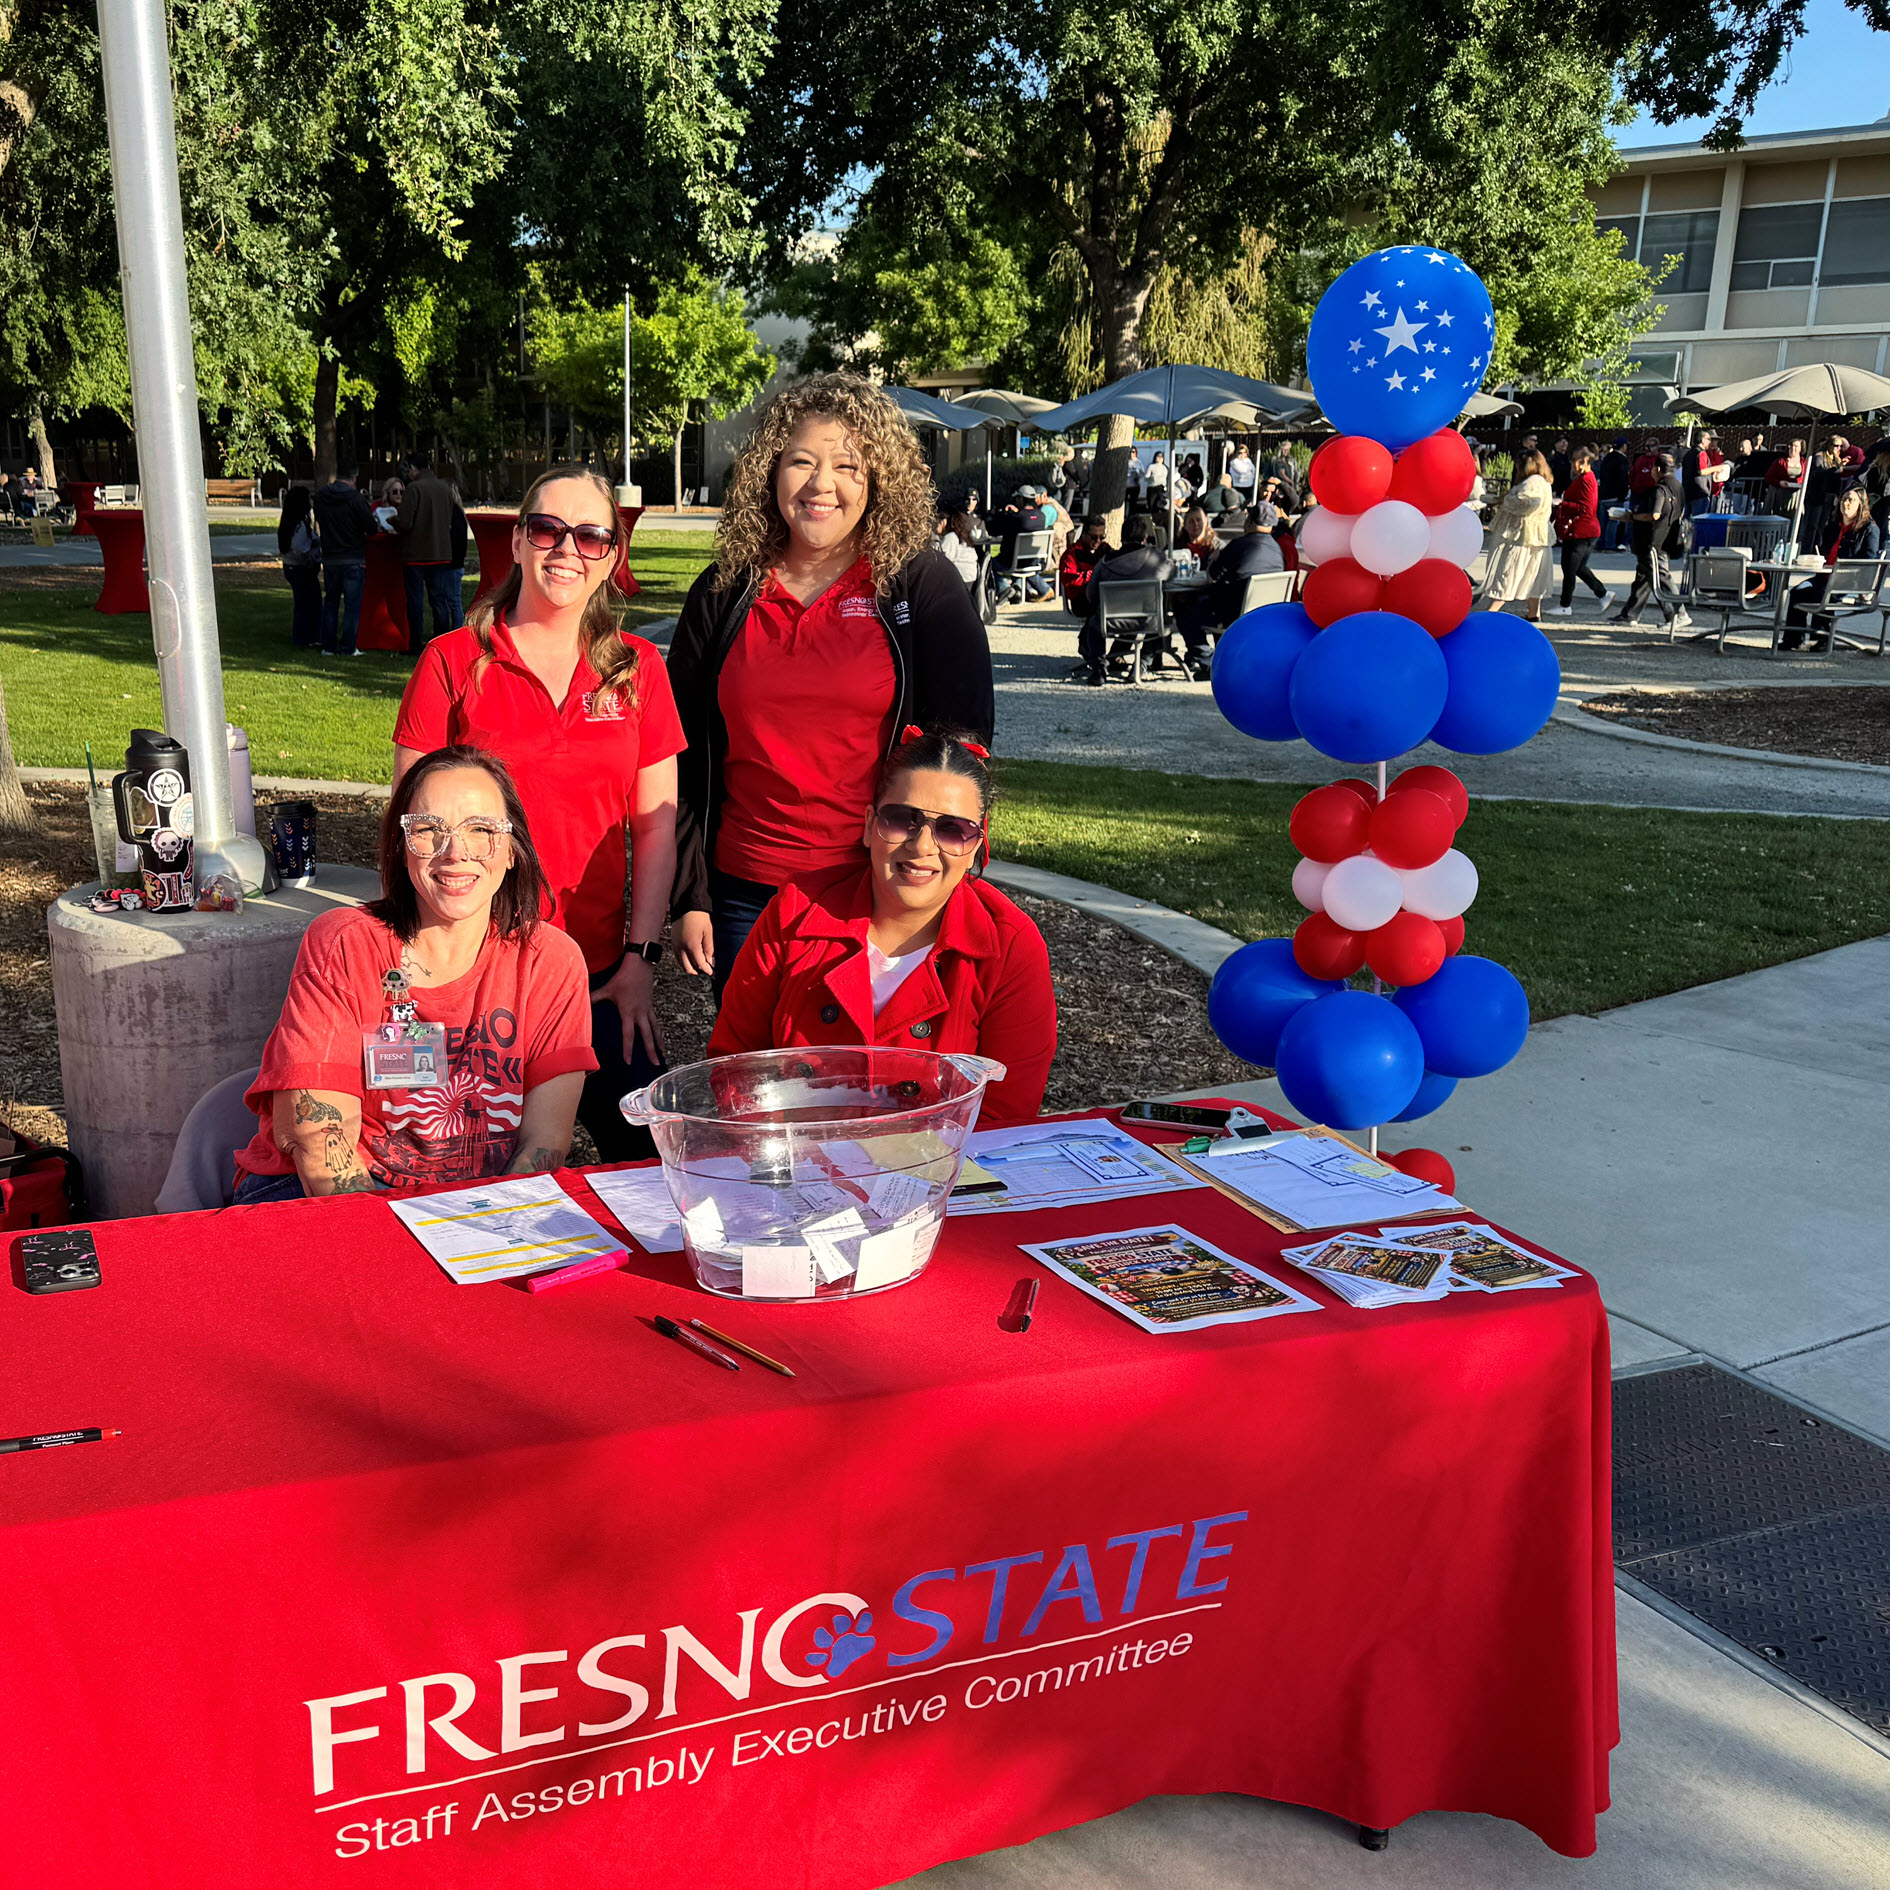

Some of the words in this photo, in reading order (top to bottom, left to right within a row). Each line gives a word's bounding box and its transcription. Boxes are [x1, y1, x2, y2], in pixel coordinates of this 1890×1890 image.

[1074, 1243, 1102, 1252] SAVE
[1119, 1236, 1155, 1245] DATE!
[1087, 1253, 1137, 1266] FRESNO
[1138, 1248, 1177, 1258] STATE
[303, 1593, 875, 1796] FRESNO
[887, 1511, 1249, 1667] STATE
[335, 1801, 459, 1859] Staff
[471, 1747, 715, 1831] Assembly
[731, 1694, 947, 1767] Executive
[964, 1632, 1193, 1709] Committee
